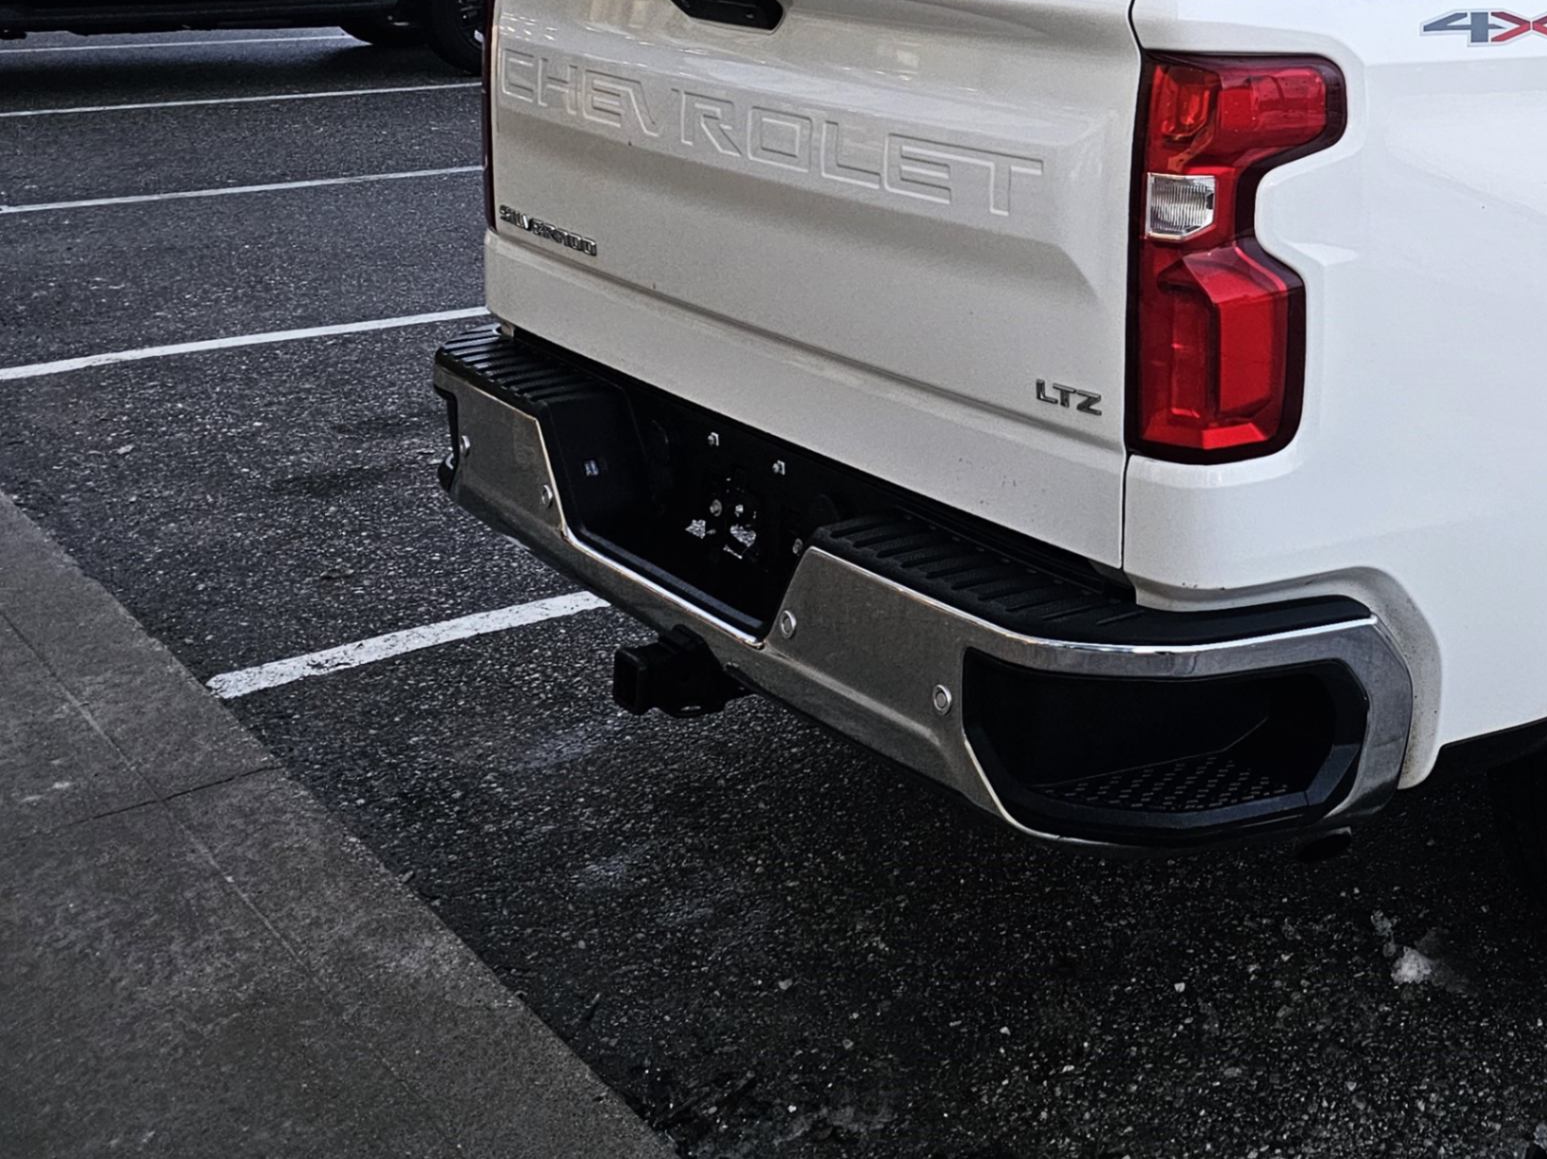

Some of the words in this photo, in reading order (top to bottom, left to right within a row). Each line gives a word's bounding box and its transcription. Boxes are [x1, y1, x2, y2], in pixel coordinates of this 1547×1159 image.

[501, 48, 1043, 215] CHEVROLET
[499, 204, 597, 256] SILVERADO
[1036, 379, 1102, 416] LTZ
